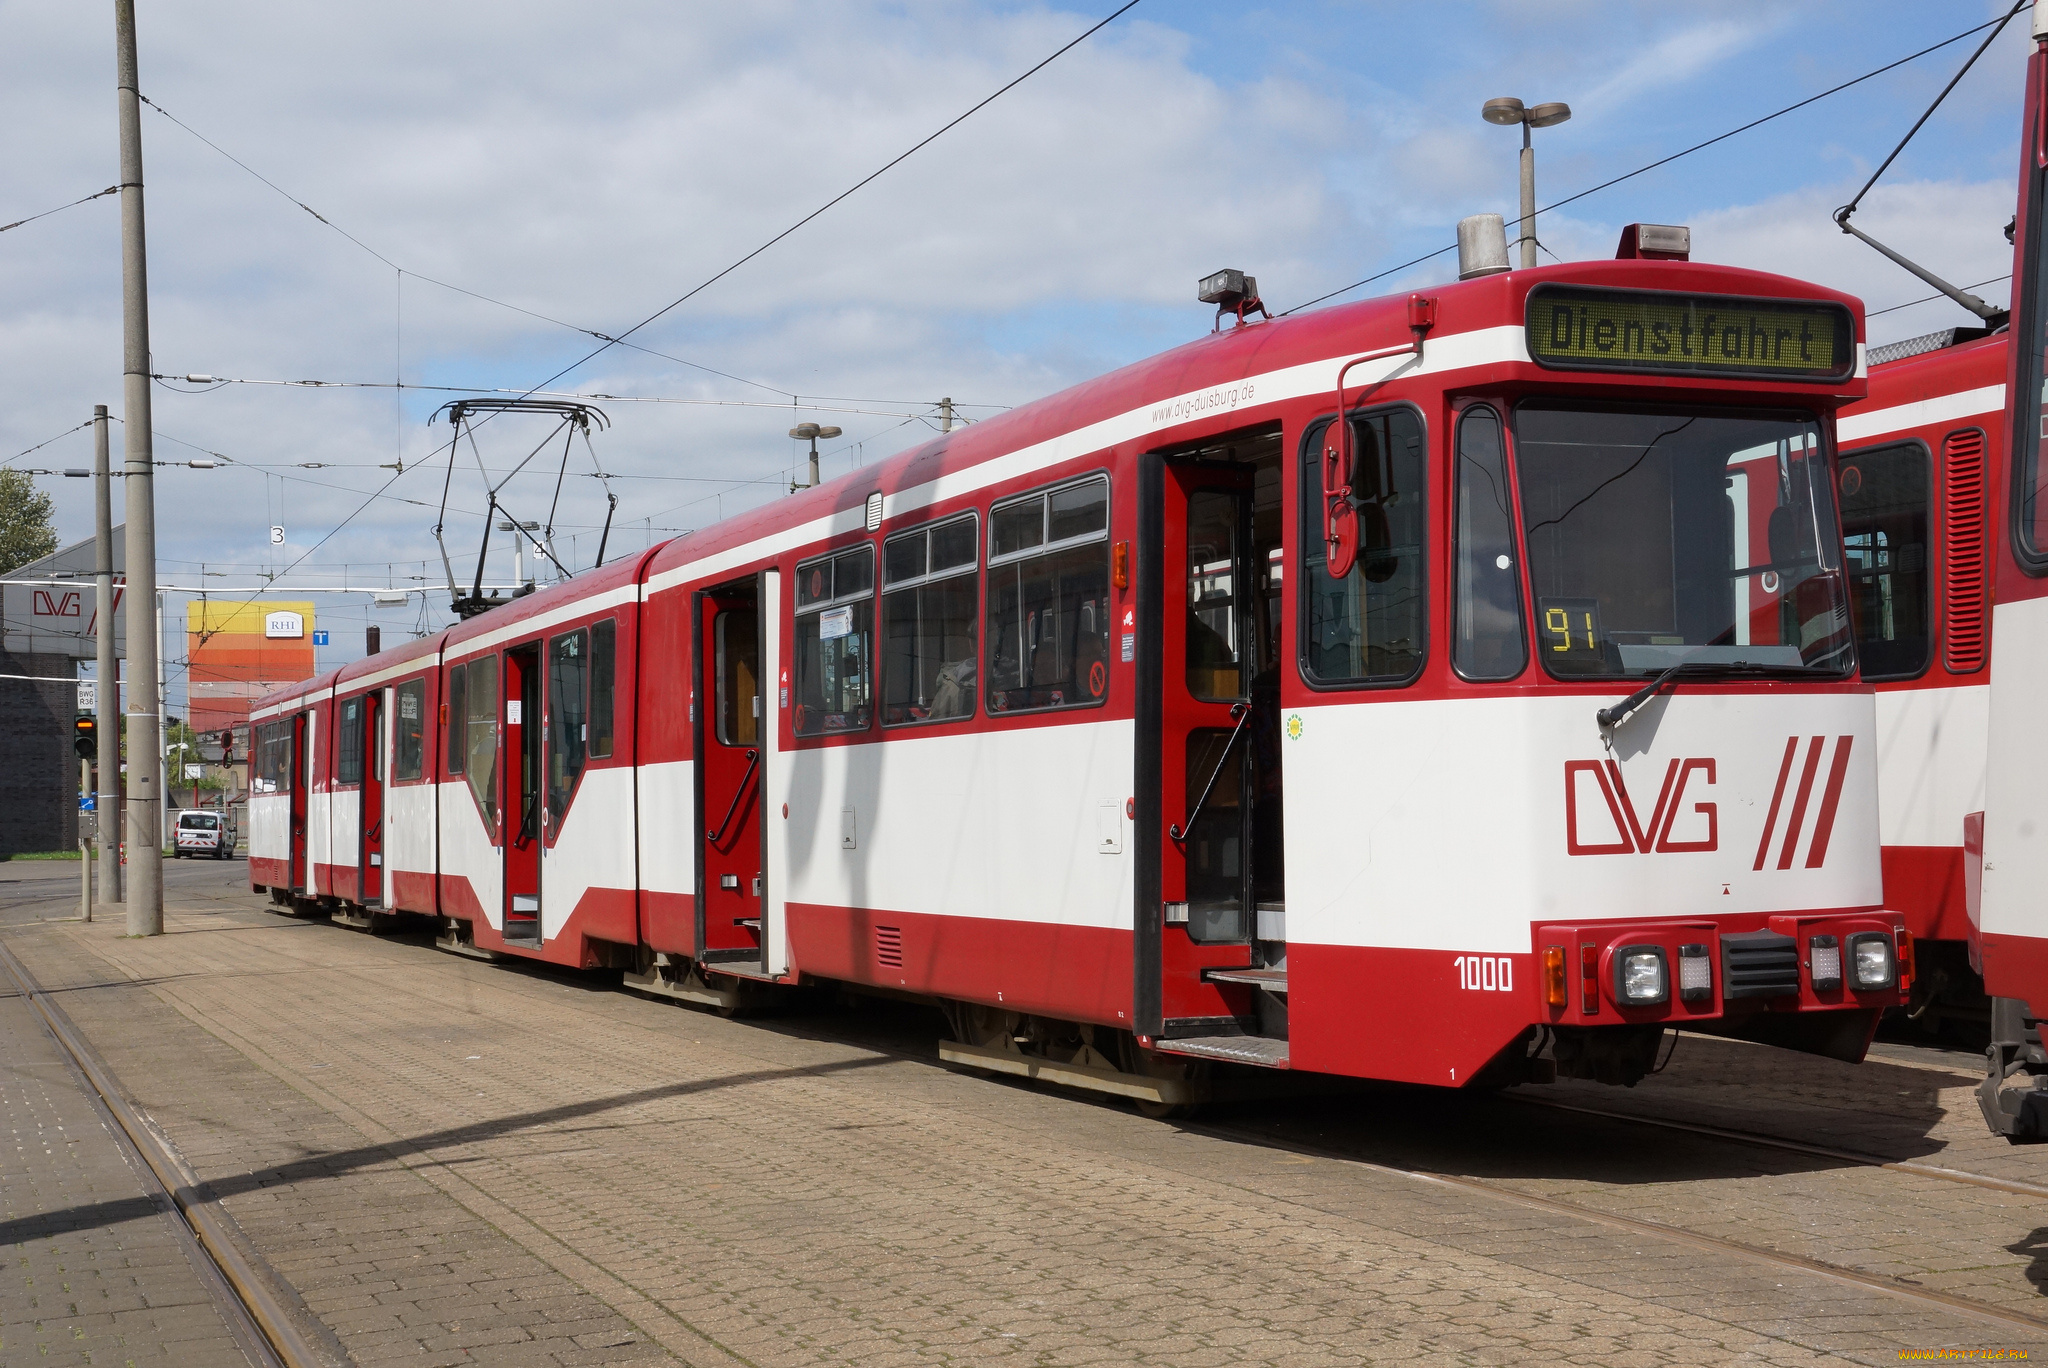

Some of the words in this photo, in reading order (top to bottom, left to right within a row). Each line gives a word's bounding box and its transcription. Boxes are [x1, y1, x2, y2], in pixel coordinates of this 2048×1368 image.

[1550, 304, 1814, 362] Dienstfahrt
[1152, 382, 1254, 423] www.dvg-duisburg.de
[272, 527, 284, 543] 3
[535, 542, 545, 557] 4
[34, 591, 80, 616] DVG
[271, 621, 295, 630] RHI
[1545, 608, 1594, 652] 91
[1564, 757, 1718, 856] DVG
[1454, 956, 1513, 992] 1000
[1449, 1068, 1455, 1081] 1
